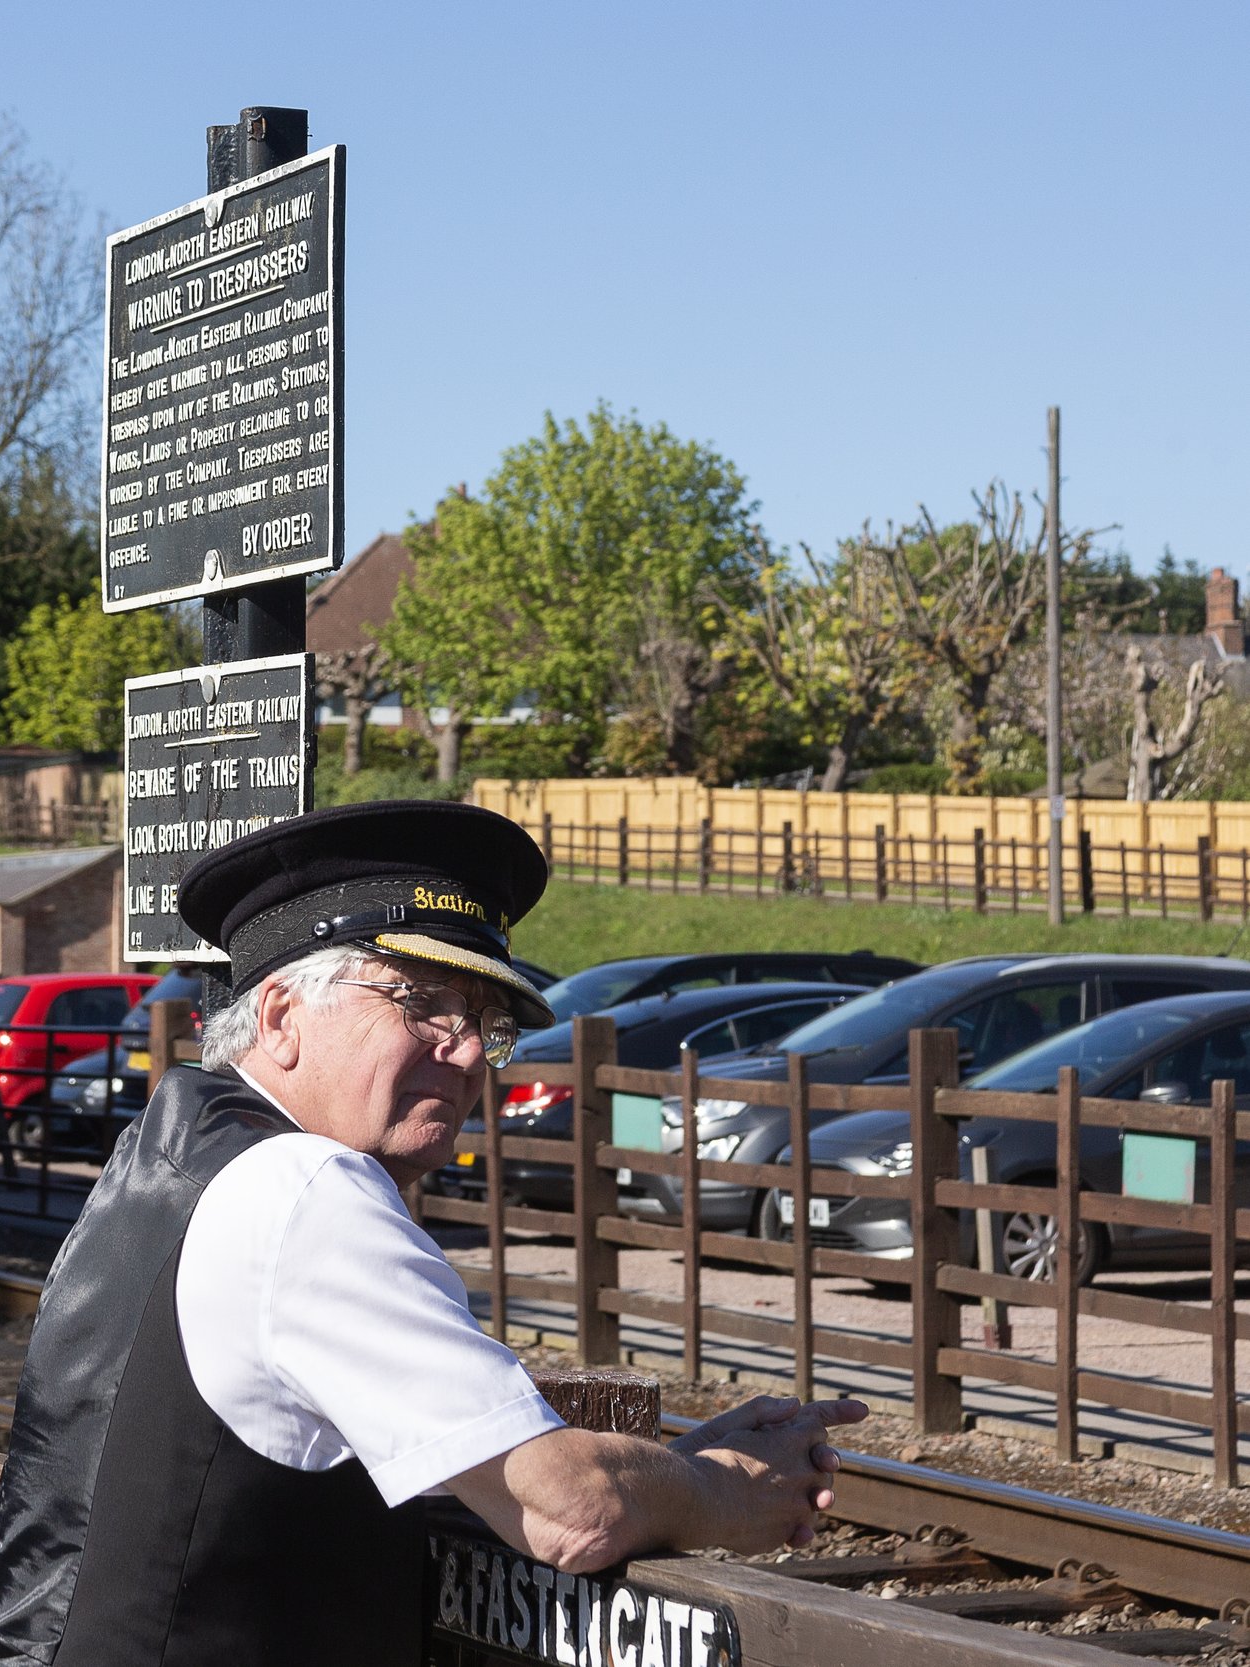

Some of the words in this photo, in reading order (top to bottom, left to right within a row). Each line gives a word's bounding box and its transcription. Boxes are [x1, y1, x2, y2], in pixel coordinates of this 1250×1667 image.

[209, 213, 259, 253] EASTERN
[265, 191, 314, 233] RAILWAY
[128, 287, 183, 331] WARNING
[187, 277, 203, 309] TO
[209, 240, 309, 302] TRESPASSERS
[111, 357, 129, 380] THE
[201, 322, 241, 350] EASTERN
[244, 306, 282, 335] RAILWAY
[283, 290, 329, 322] COMPANY
[111, 389, 144, 412] HEREBY
[147, 378, 168, 400] GIVE
[171, 366, 207, 392] WARNING
[211, 360, 222, 380] TO
[226, 354, 245, 376] ALL
[247, 340, 288, 368] PERSONS
[293, 331, 311, 352] NOT
[316, 326, 329, 346] TO
[111, 416, 149, 442] TRESPASS
[152, 407, 175, 430] UPON
[178, 401, 195, 422] ANY
[196, 397, 209, 416] OF
[212, 390, 230, 412] THE
[143, 442, 171, 465] LANDS
[176, 436, 188, 454] OR
[190, 421, 236, 451] PROPERTY
[240, 408, 290, 438] BELONGING
[296, 402, 308, 421] TO
[314, 395, 329, 416] OR
[110, 482, 142, 505] WORKED
[148, 476, 159, 496] BY
[165, 471, 183, 491] THE
[237, 438, 302, 471] TRESPASSERS
[309, 430, 329, 451] ARE
[109, 514, 139, 537] LIABLE
[143, 509, 152, 527] TO
[158, 506, 165, 525] A
[168, 500, 188, 522] FINE
[192, 497, 204, 516] OR
[208, 479, 267, 513] IMPRISONMENT
[272, 474, 291, 496] FOR
[296, 463, 329, 490] EVERY
[110, 543, 150, 568] OFFENCE.
[242, 523, 260, 557] BY
[263, 512, 312, 551] ORDER
[206, 700, 254, 729] EASTERN
[257, 695, 300, 724] RAILWAY
[129, 768, 176, 798] BEWARE
[184, 762, 203, 793] OF
[212, 757, 239, 790] THE
[248, 754, 299, 788] TRAINS
[129, 825, 157, 855] LOOK
[158, 821, 188, 853] BOTH
[191, 819, 207, 851] UP
[208, 819, 232, 850] AND
[129, 885, 155, 915] LINE
[414, 886, 487, 922] Station
[470, 1550, 602, 1666] FASTEN
[609, 1587, 716, 1666] GATE
